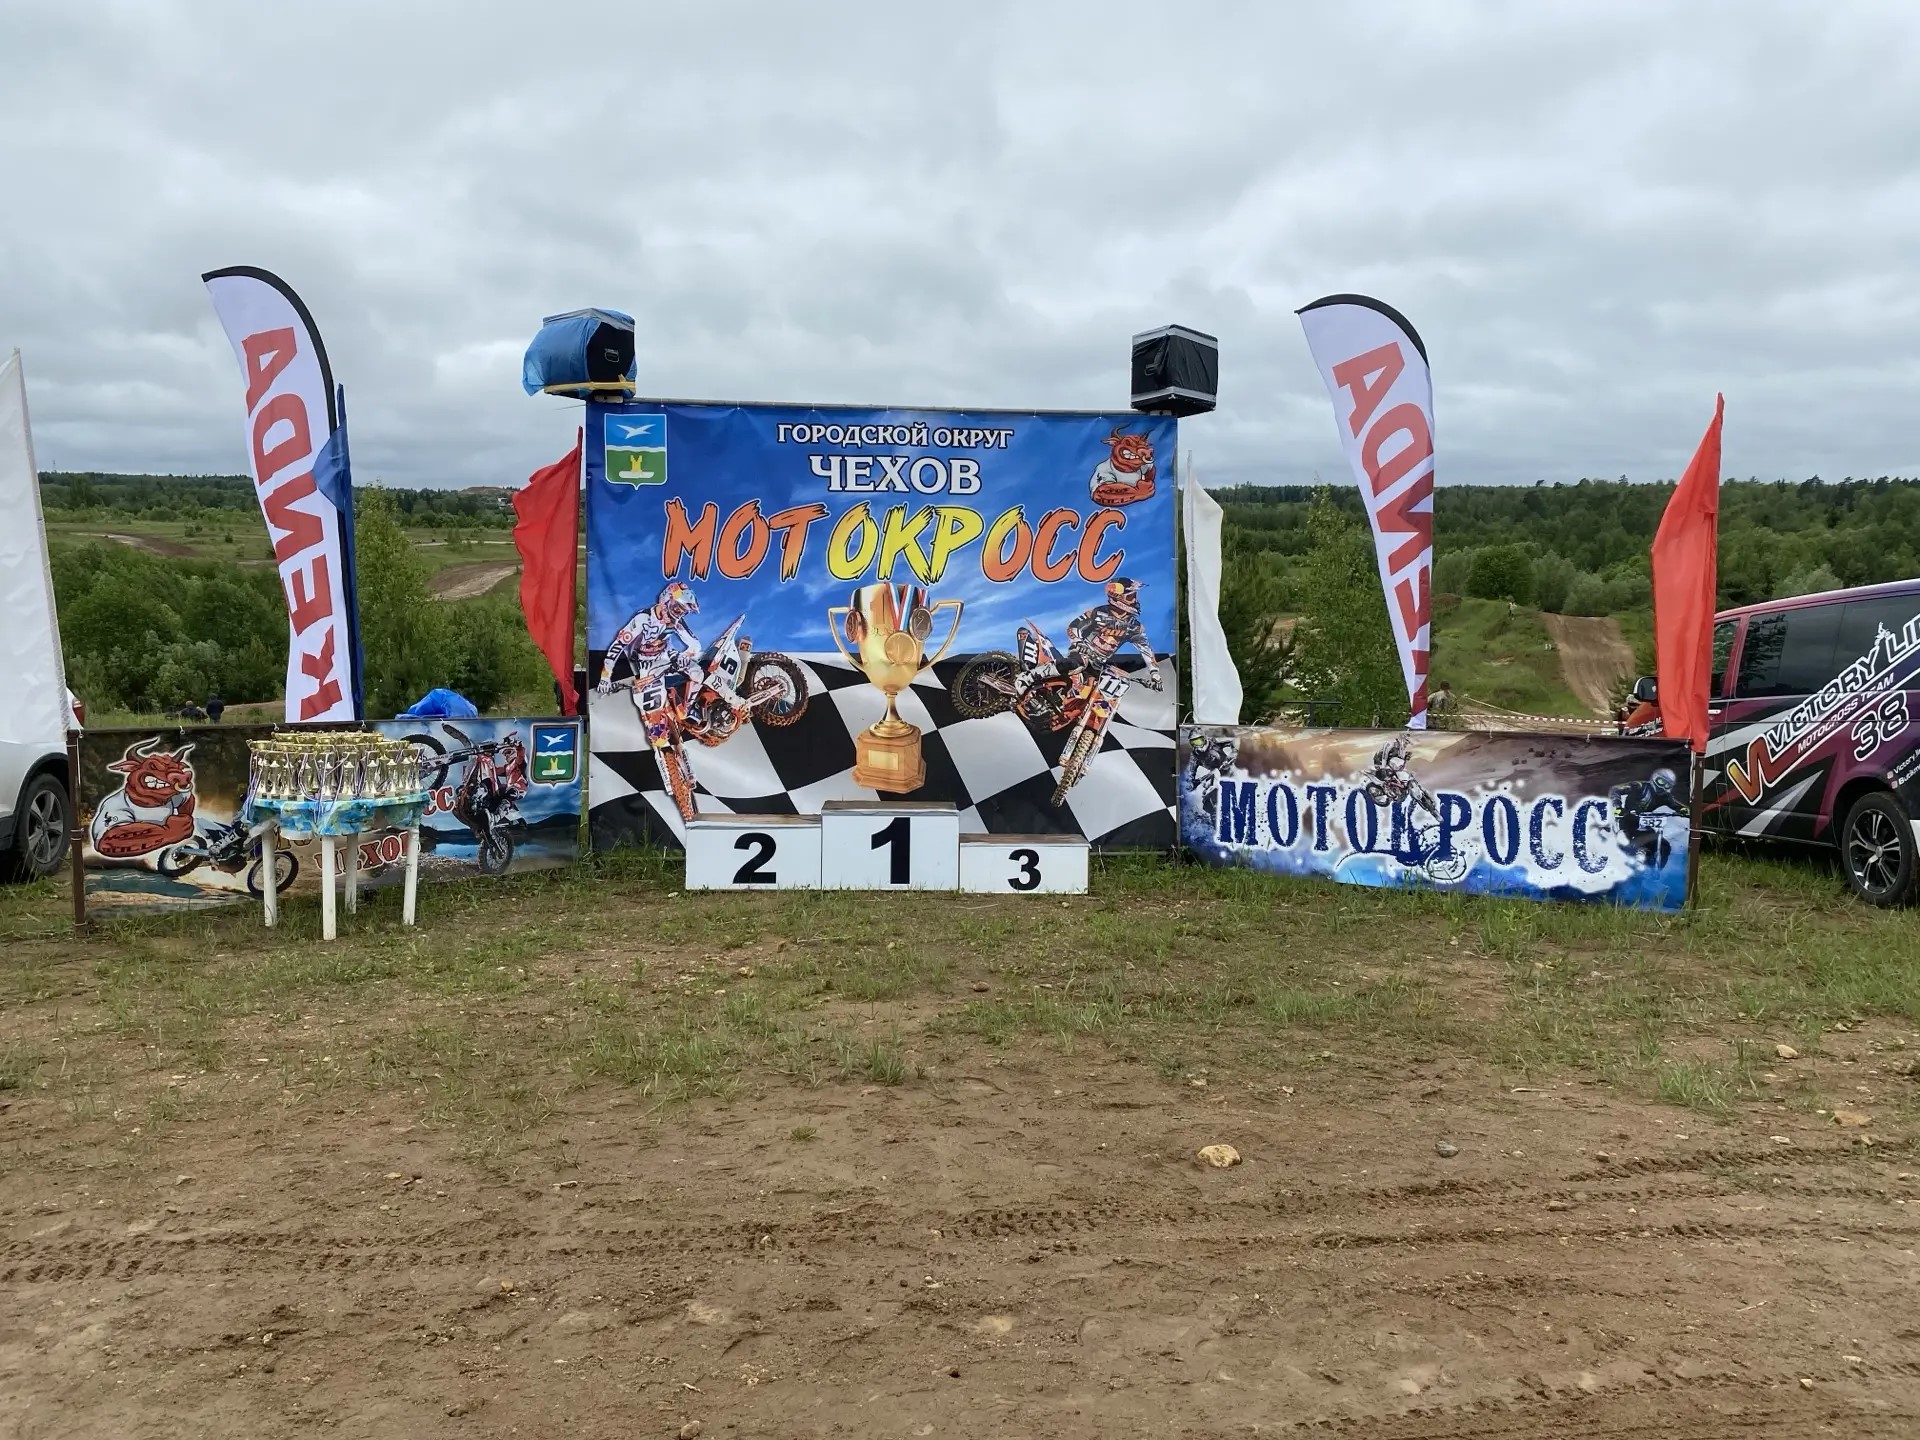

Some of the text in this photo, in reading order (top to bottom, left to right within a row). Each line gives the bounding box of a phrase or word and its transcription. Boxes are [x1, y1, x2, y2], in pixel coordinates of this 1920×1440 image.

[777, 422, 1014, 449] ГОРОДСКОЙ ОКРУГ
[809, 455, 982, 495] ЧЕХОВ
[662, 498, 1128, 584] МОТОКРОСС
[642, 689, 662, 712] 5
[1765, 645, 1881, 753] VICTORY
[1797, 672, 1895, 754] MOTOCROSS TEAM
[1851, 690, 1910, 762] 38
[732, 832, 777, 885] 2
[870, 816, 911, 885] 1
[1007, 848, 1042, 891] 3
